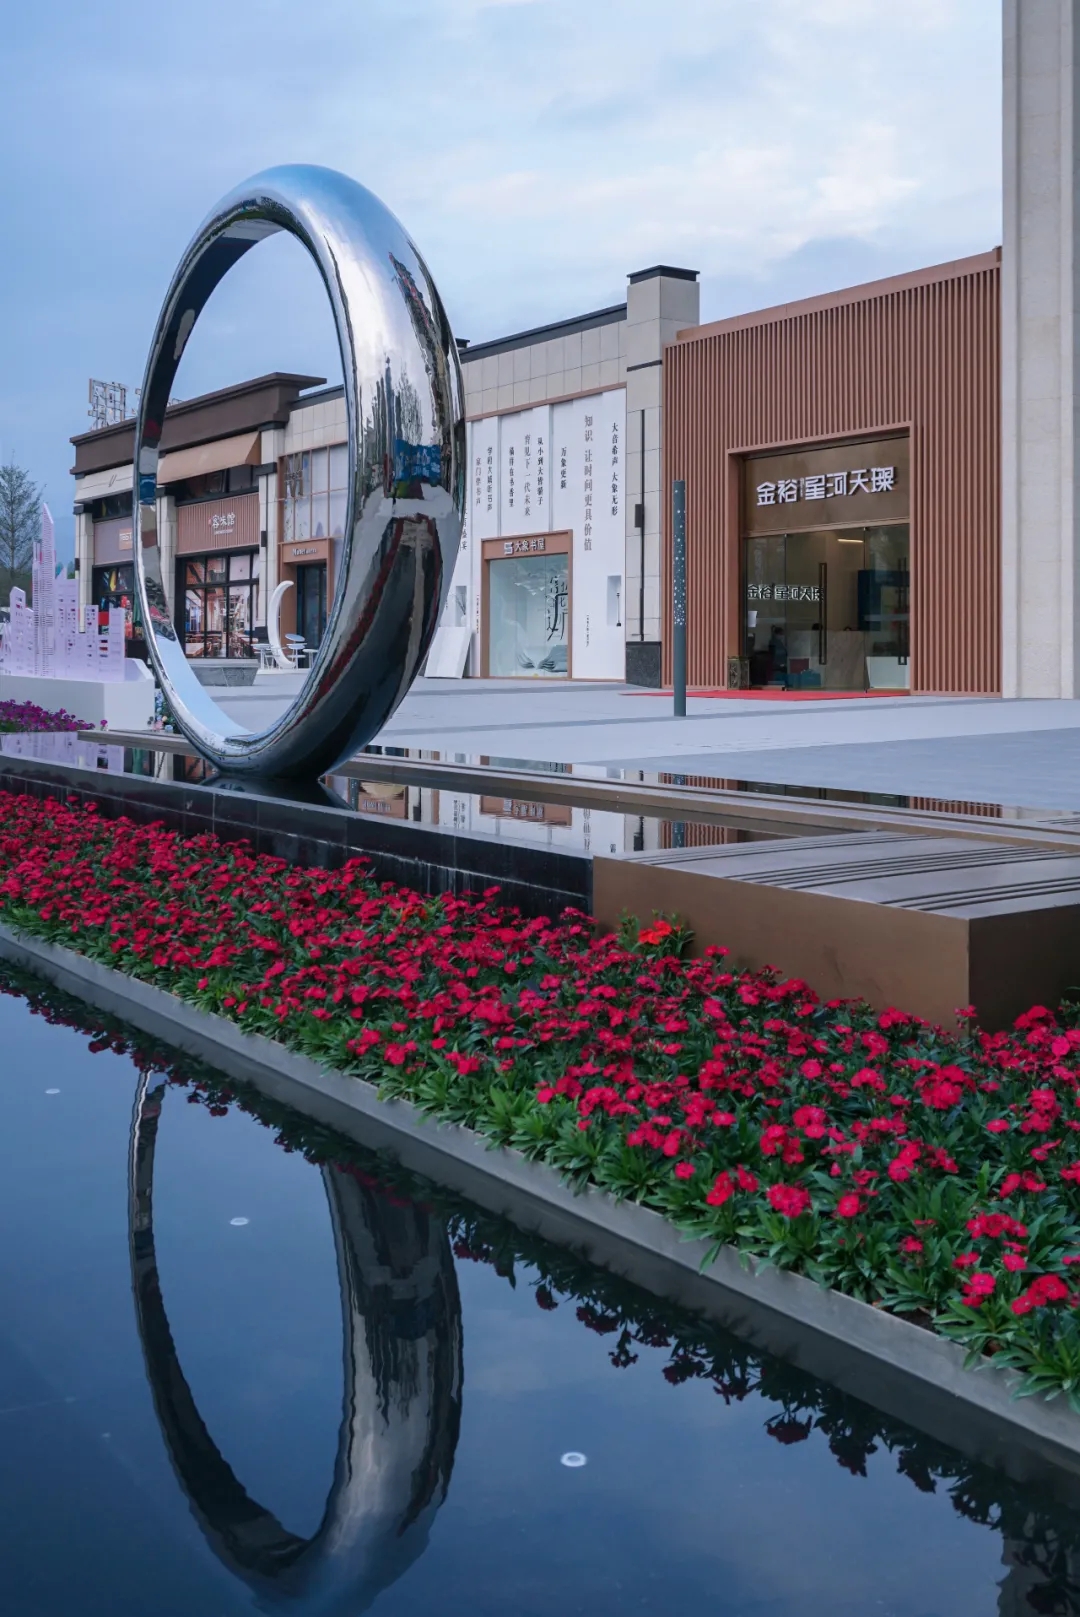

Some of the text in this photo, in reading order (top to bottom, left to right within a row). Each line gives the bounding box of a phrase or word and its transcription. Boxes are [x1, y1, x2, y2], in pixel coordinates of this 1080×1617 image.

[584, 414, 593, 551] 知识 让时间更具价值
[611, 422, 619, 517] 大音希声 大象无形
[515, 537, 545, 552] 大象书屋
